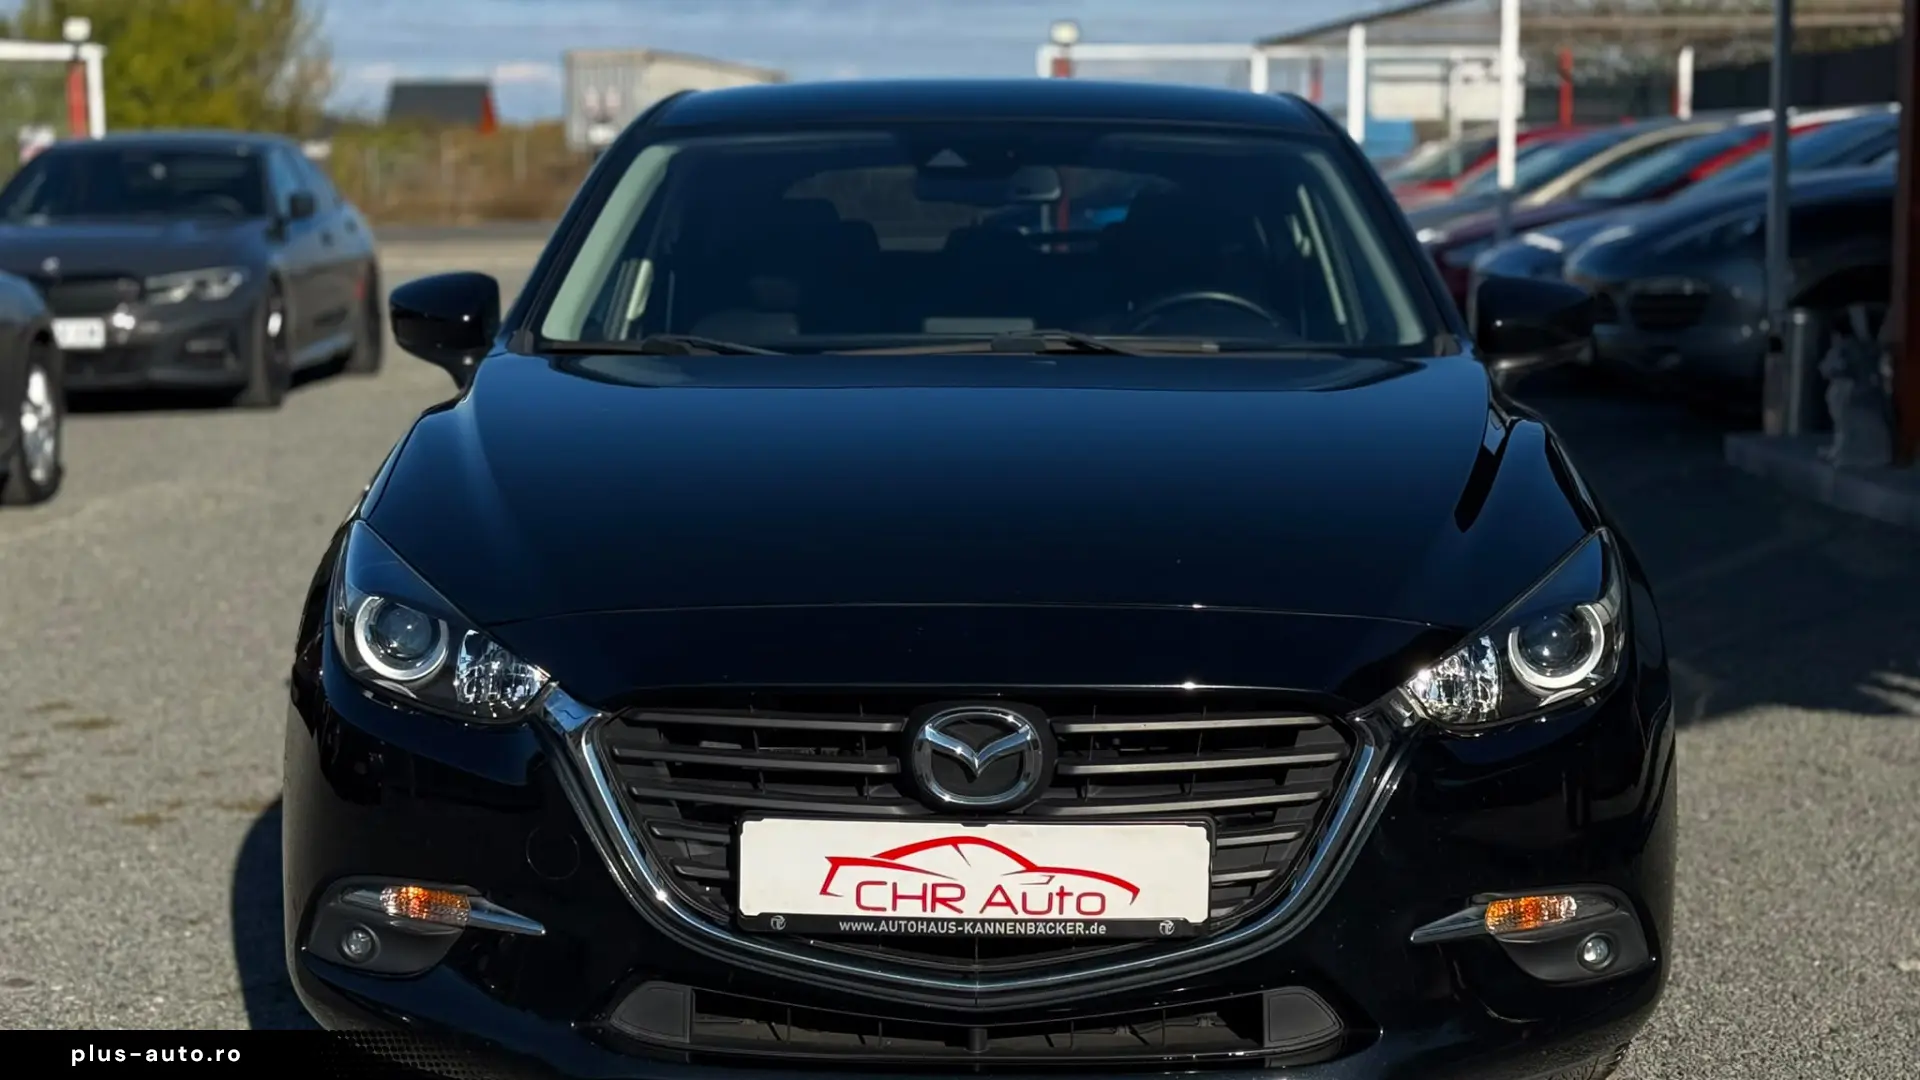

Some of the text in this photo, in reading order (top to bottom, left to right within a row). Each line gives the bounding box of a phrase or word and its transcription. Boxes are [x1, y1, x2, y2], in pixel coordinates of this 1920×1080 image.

[855, 880, 1107, 916] CHR Auto
[838, 919, 1107, 936] www.AUTOHAUS-KANNENBÄCKER.de
